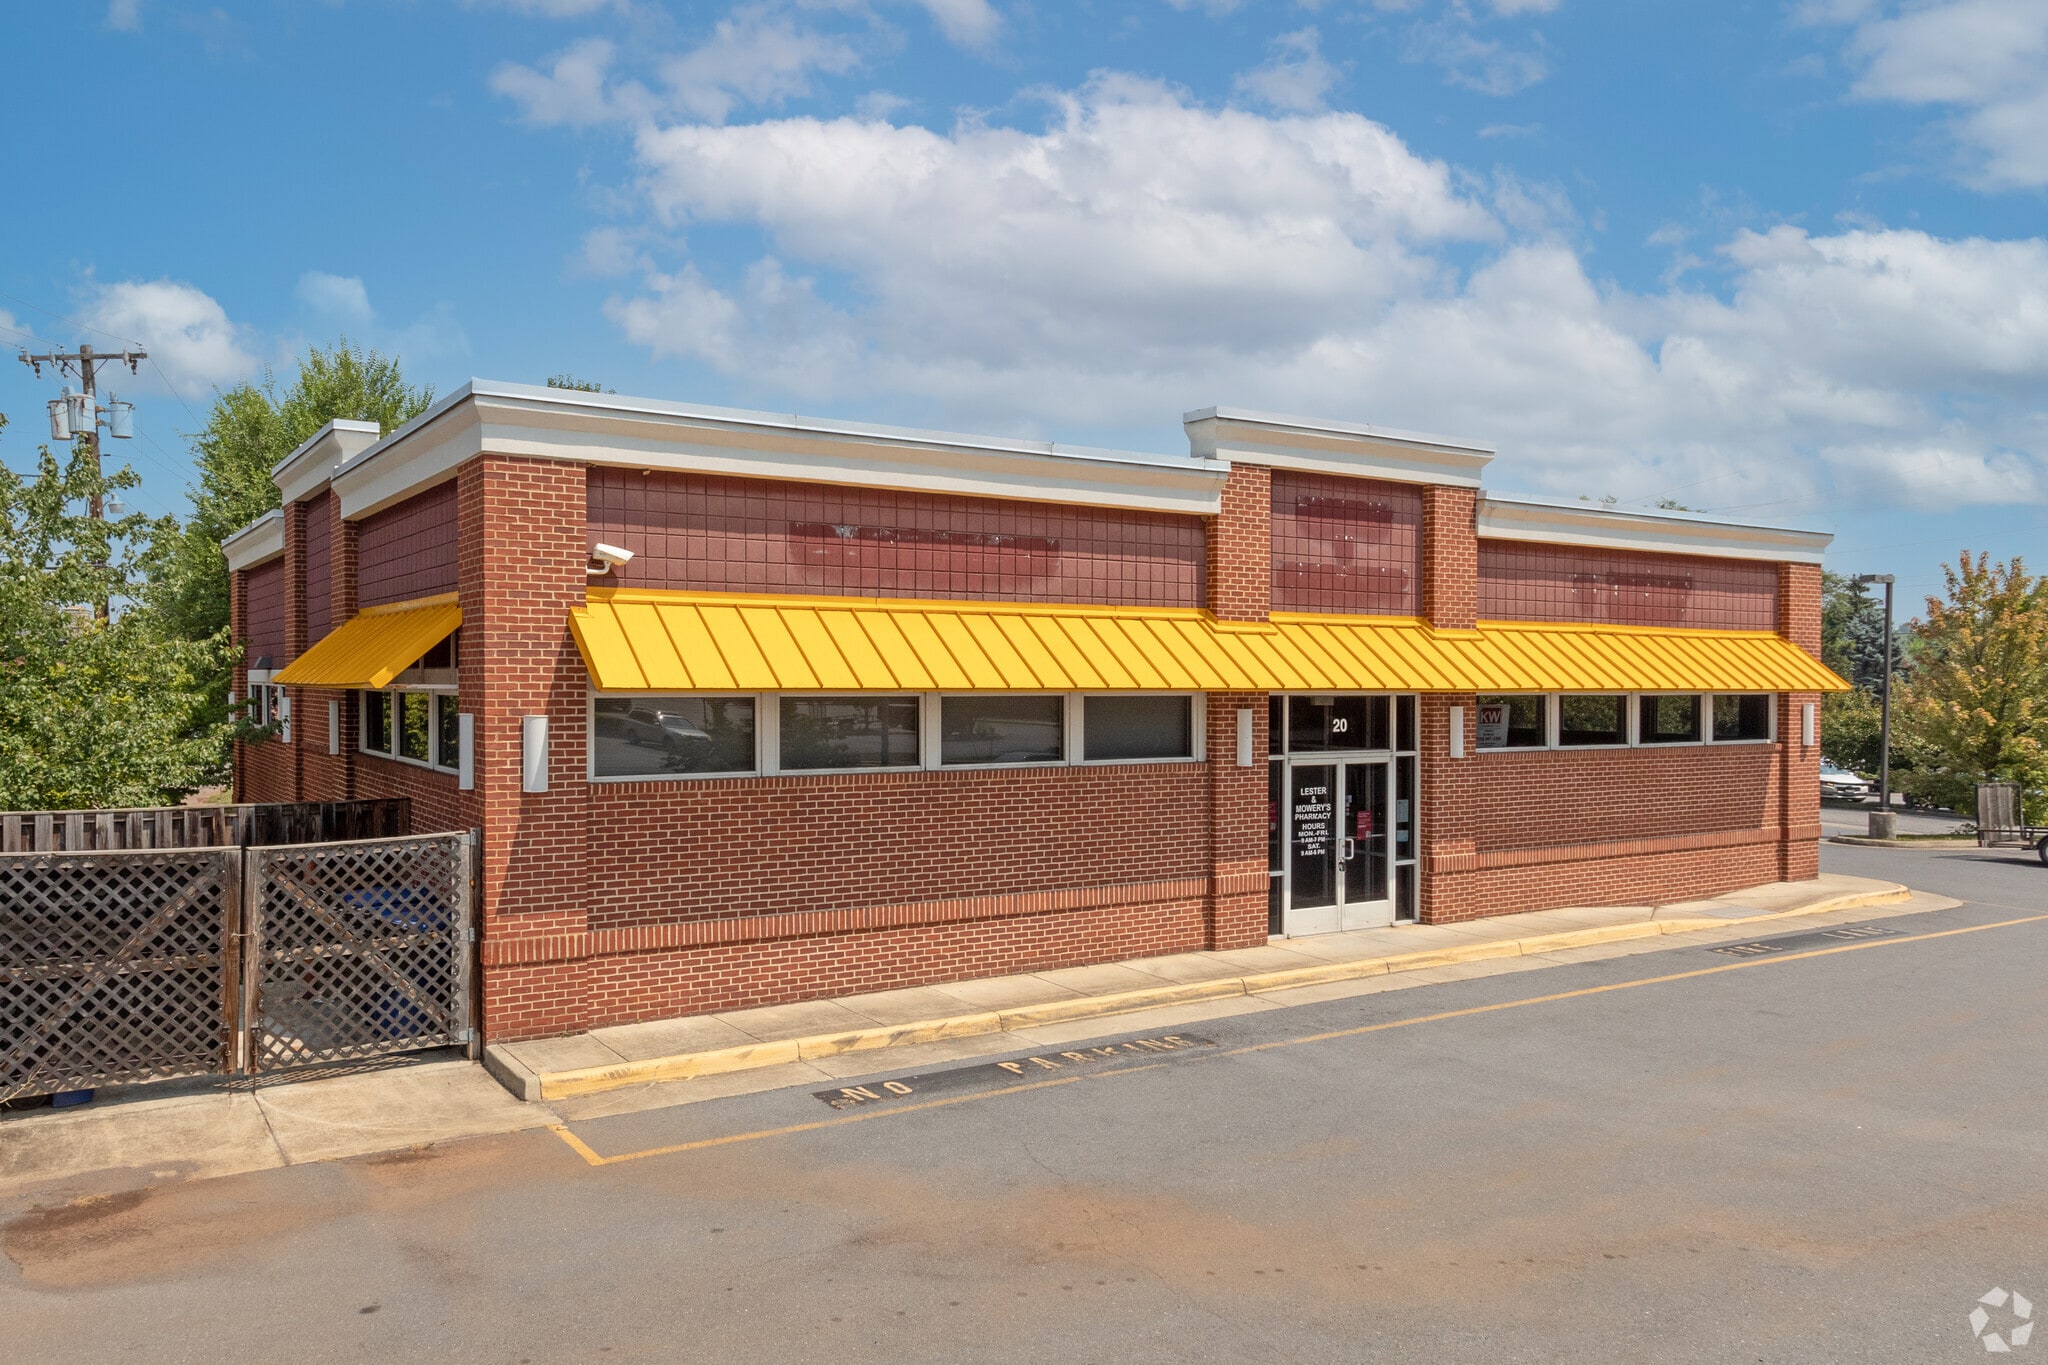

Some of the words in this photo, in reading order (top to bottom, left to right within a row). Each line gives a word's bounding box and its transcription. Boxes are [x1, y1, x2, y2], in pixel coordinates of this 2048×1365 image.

[1480, 710, 1501, 723] KW
[1332, 718, 1348, 733] 20
[1300, 786, 1327, 796] LESTER
[1311, 795, 1317, 803] &
[1295, 803, 1331, 813] MOWERY'S
[1294, 812, 1331, 821] PHARMACY
[1302, 822, 1326, 830] HOURS
[840, 1081, 913, 1101] NO
